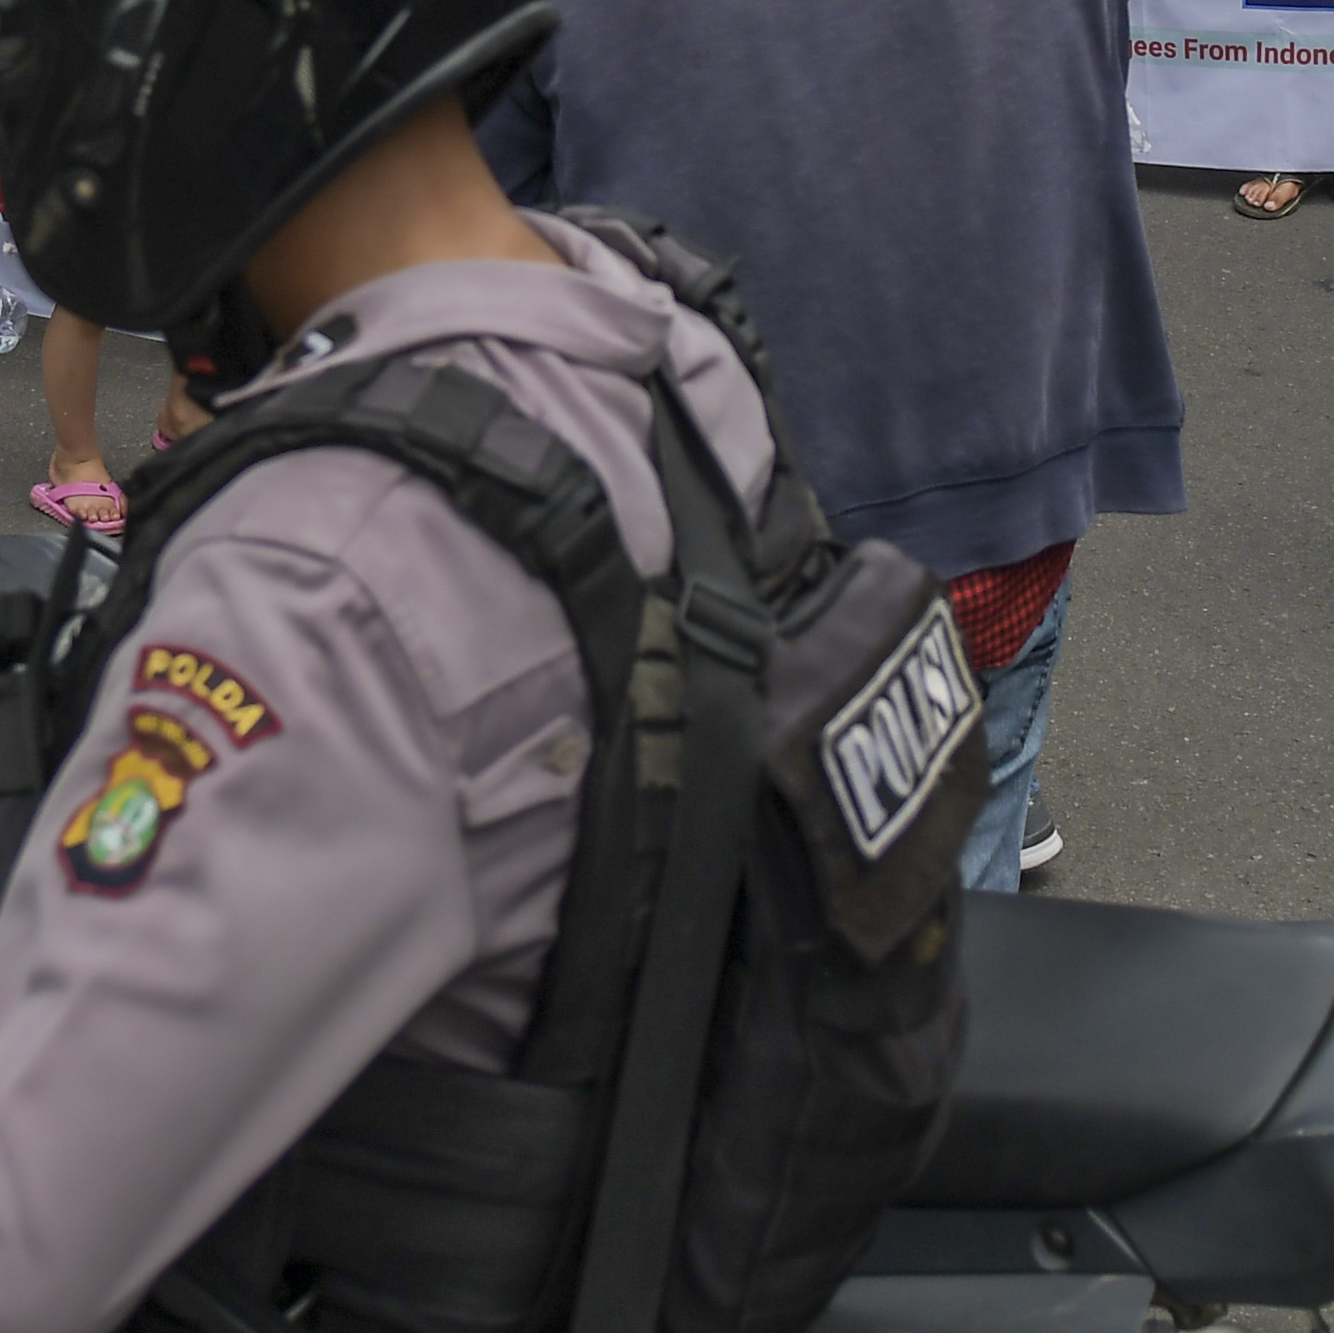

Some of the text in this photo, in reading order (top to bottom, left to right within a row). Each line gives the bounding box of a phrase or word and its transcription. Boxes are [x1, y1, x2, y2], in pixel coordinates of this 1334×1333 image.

[1129, 39, 1176, 58] ees
[1184, 37, 1248, 62] From
[143, 648, 266, 738] POLDA
[836, 618, 971, 834] POLISI
